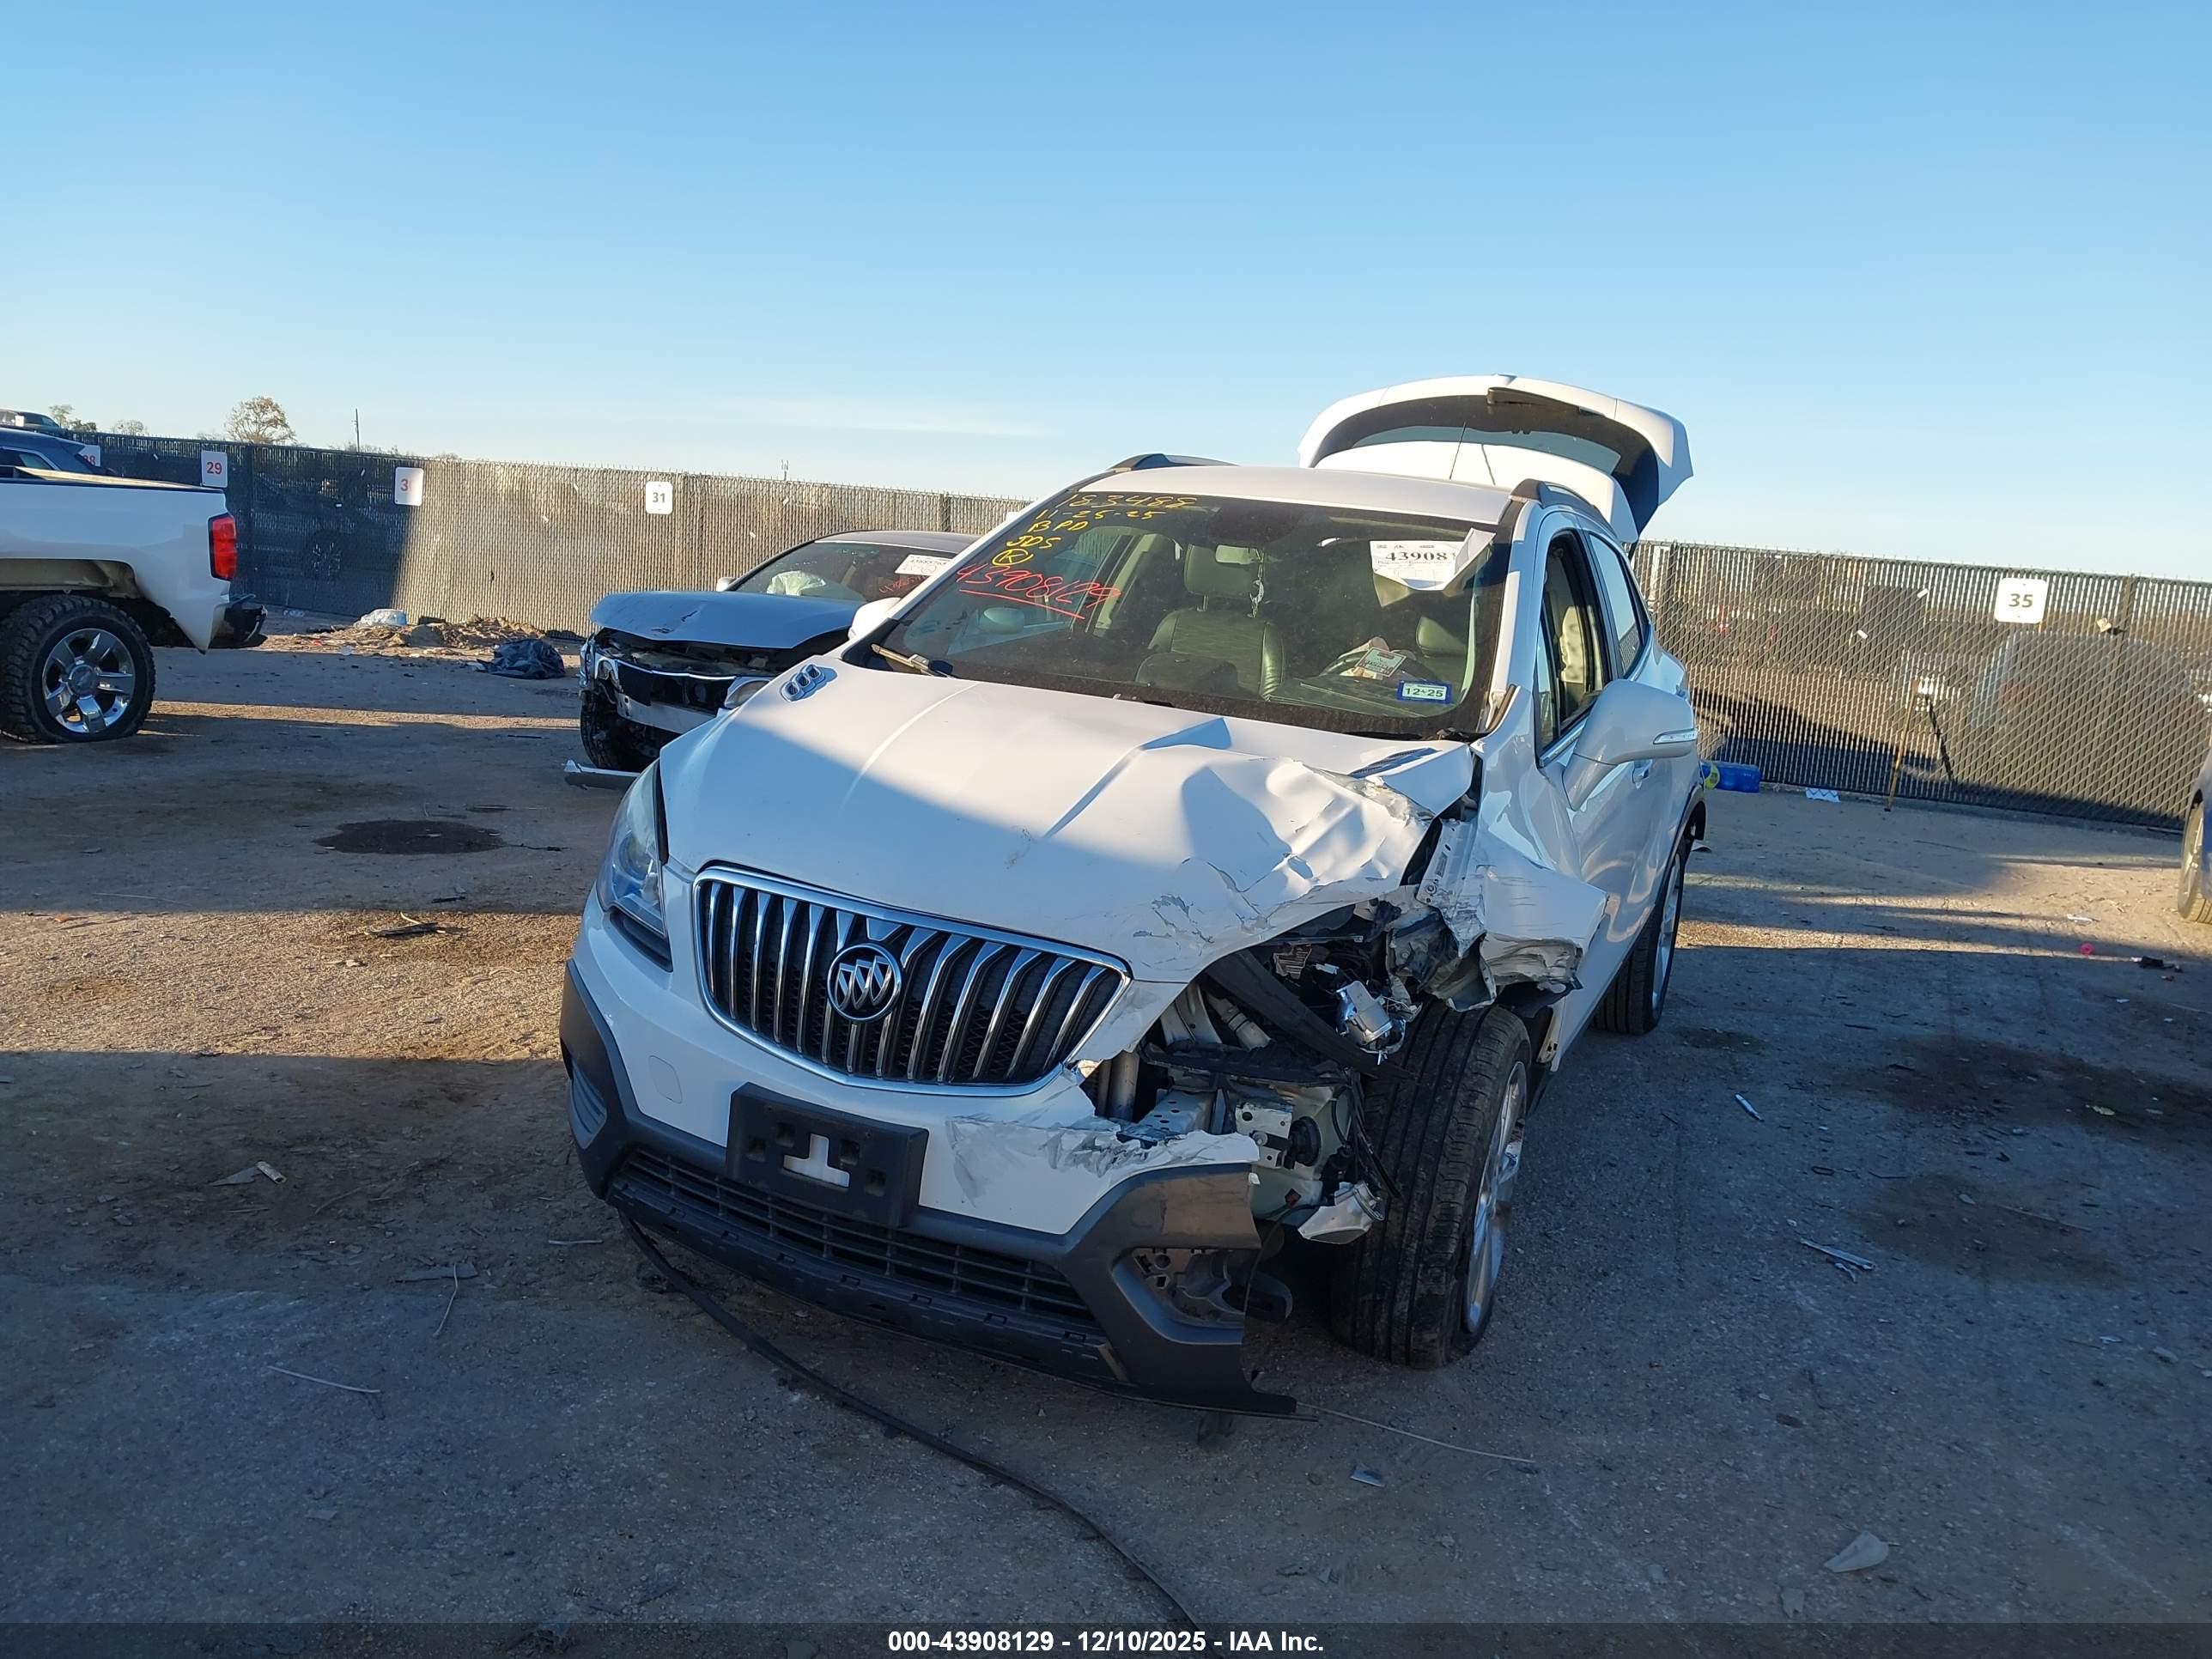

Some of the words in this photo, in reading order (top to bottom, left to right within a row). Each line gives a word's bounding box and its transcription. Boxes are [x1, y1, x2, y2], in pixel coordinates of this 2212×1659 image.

[206, 461, 222, 475] 29
[652, 492, 665, 503] 31
[956, 563, 1121, 608] 43908129
[2008, 592, 2033, 608] 35
